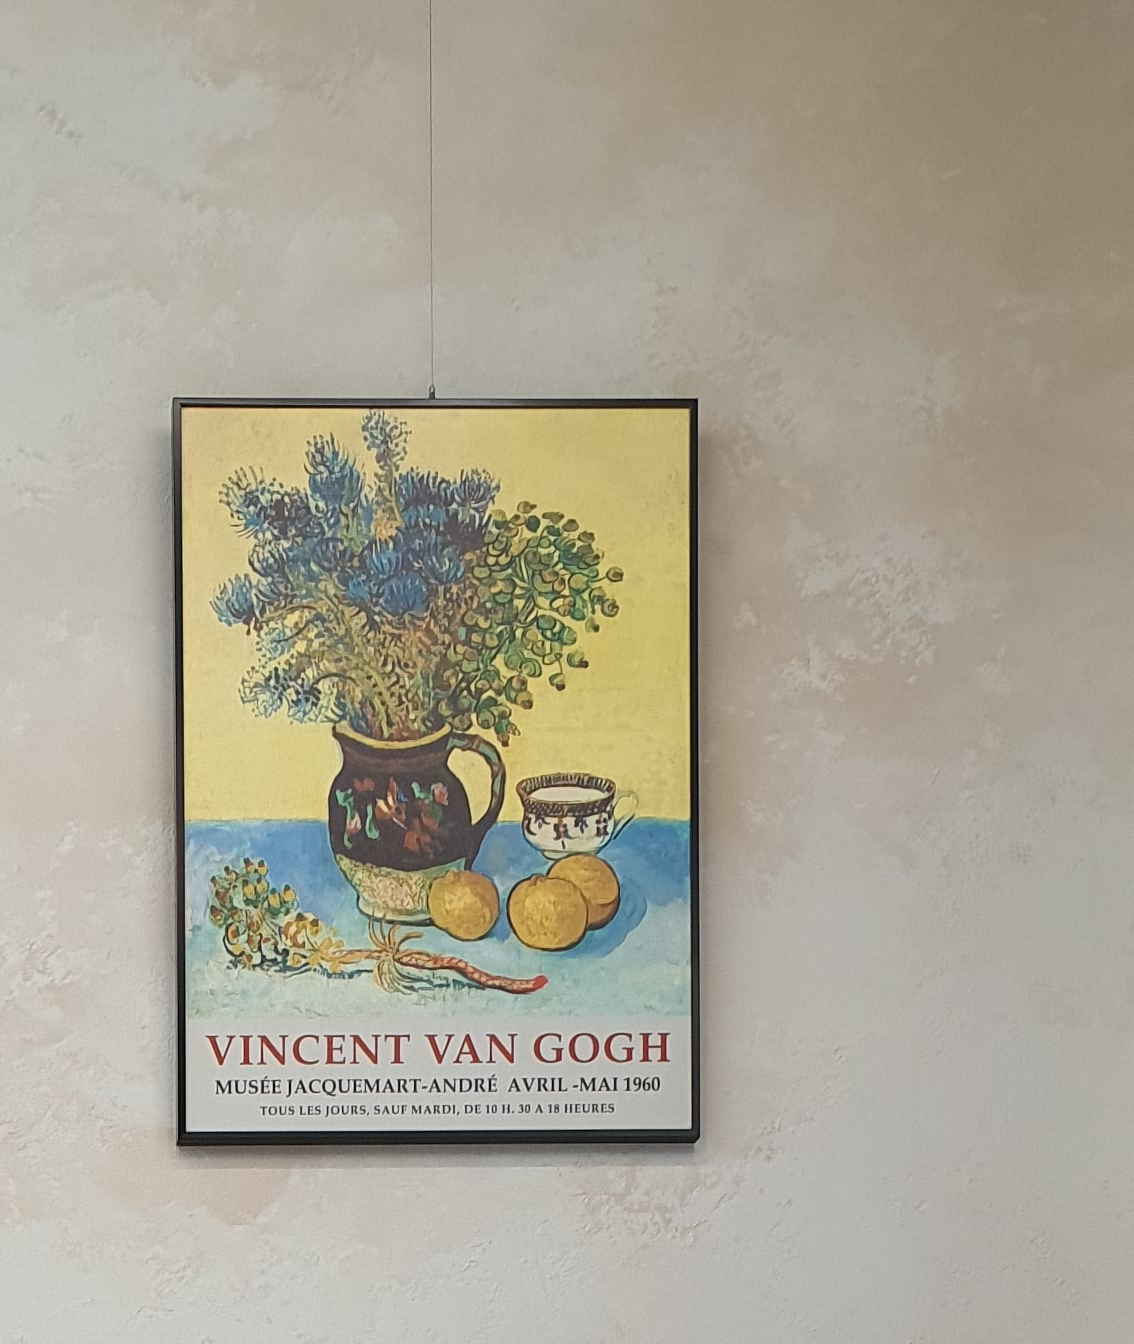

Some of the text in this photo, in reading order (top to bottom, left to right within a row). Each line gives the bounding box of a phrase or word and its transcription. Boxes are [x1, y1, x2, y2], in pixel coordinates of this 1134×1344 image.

[205, 1032, 671, 1066] VINCENT VAN GOGH
[215, 1076, 282, 1095] MUSÉE
[286, 1073, 498, 1098] JACQUEMART-ANDRÉ
[507, 1077, 568, 1093] AVRIL
[623, 1076, 661, 1092] 1960
[260, 1105, 295, 1116] TOUS
[299, 1105, 322, 1116] LES
[325, 1105, 370, 1118] JOURS,
[373, 1104, 408, 1116] SAUF
[411, 1104, 460, 1116] MARDI,
[463, 1104, 482, 1115] DE
[485, 1104, 498, 1114] 10
[501, 1104, 515, 1114] H.
[518, 1103, 531, 1114] 30
[547, 1103, 560, 1114] 18
[564, 1103, 616, 1114] HEURES
